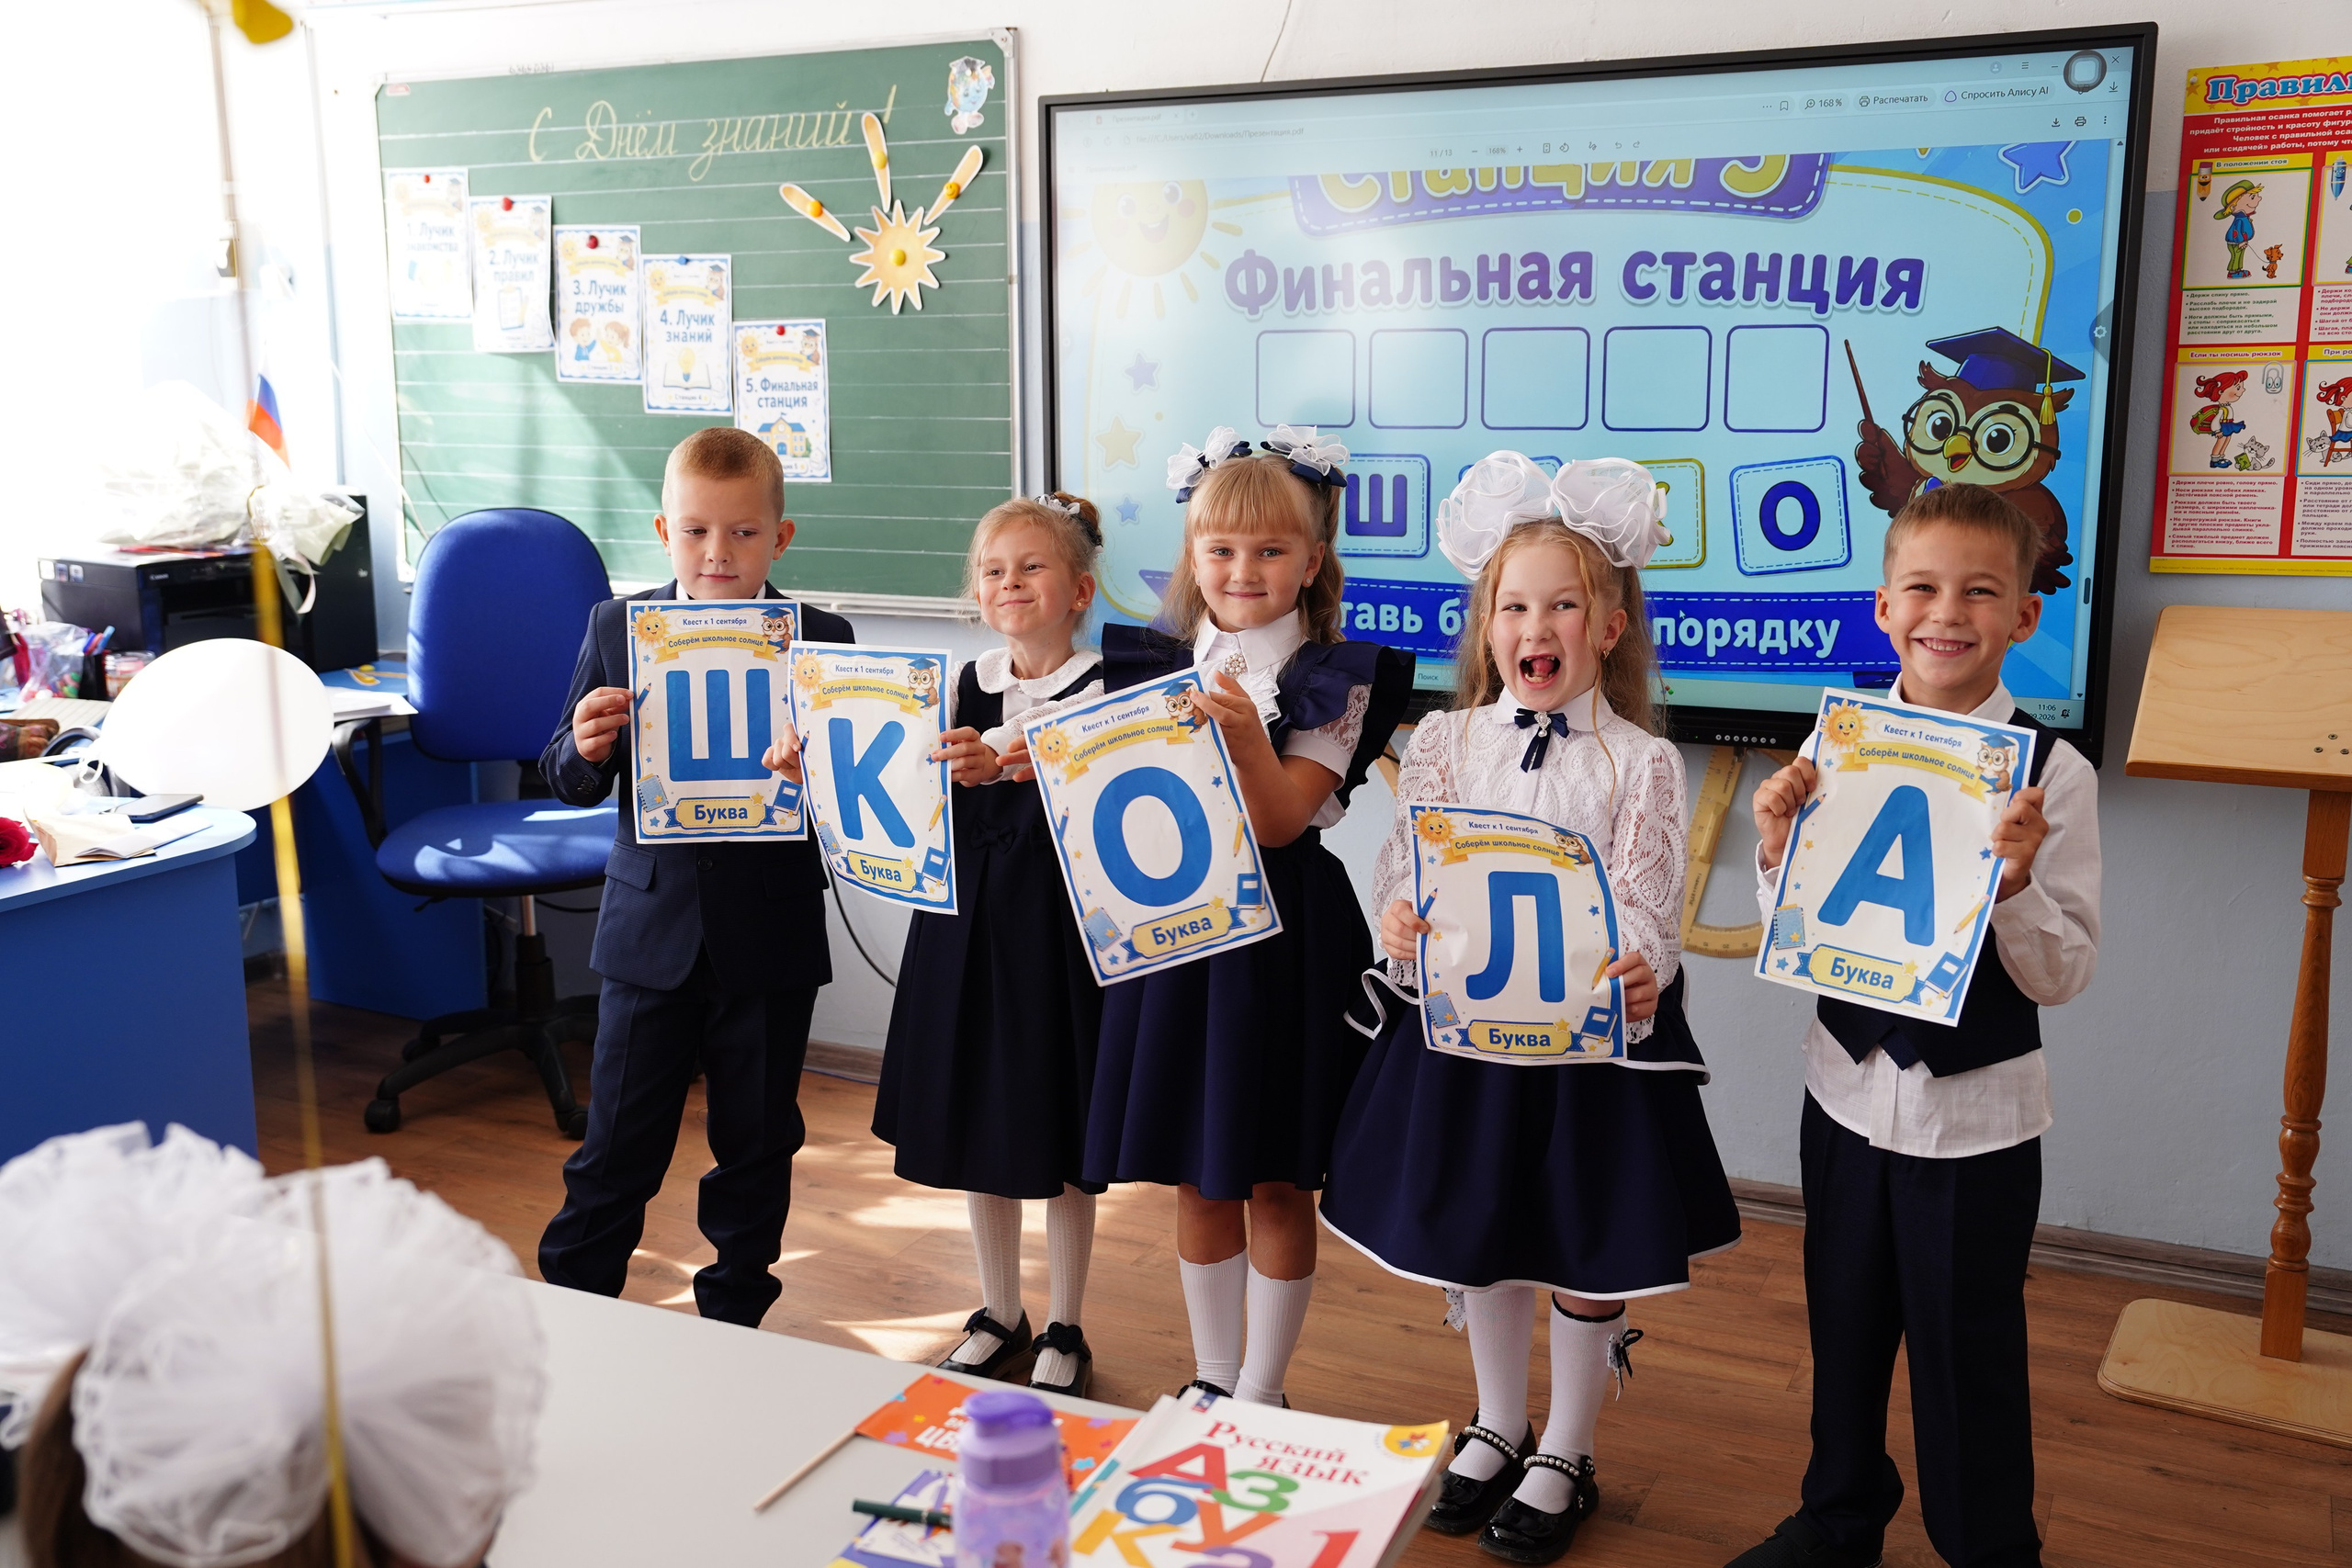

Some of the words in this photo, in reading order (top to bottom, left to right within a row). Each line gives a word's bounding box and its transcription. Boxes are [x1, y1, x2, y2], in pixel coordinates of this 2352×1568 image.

[1872, 95, 1928, 105] Распечатать
[1961, 90, 2006, 100] Спросить
[2007, 88, 2037, 97] Алису
[2214, 116, 2266, 124] Правильная
[2226, 125, 2275, 133] стройность
[2286, 121, 2321, 130] красоту
[528, 107, 552, 163] С
[574, 100, 679, 160] Днём
[2279, 130, 2333, 141] правильной
[503, 249, 539, 268] Лучик
[493, 270, 535, 285] правил
[1225, 249, 1592, 317] Финальная
[1621, 251, 1927, 316] станция
[588, 279, 627, 299] Лучик
[575, 299, 625, 316] дружбы
[676, 309, 715, 329] Лучик
[666, 328, 713, 343] знаний
[746, 378, 758, 393] 5.
[761, 377, 818, 392] Финальная
[757, 395, 808, 409] станция
[1345, 473, 1408, 537] Ш
[1758, 480, 1821, 551] О
[716, 617, 747, 626] сентября
[668, 637, 700, 648] Соберём
[739, 637, 764, 648] солнце
[1653, 617, 1840, 659] порядку
[835, 664, 853, 673] Квест
[865, 666, 894, 675] сентября
[822, 684, 851, 695] Соберём
[853, 684, 885, 694] школьное
[886, 688, 910, 700] солнце
[666, 669, 772, 782] Ш
[1081, 720, 1102, 733] Квест
[1110, 715, 1114, 723] 1
[1116, 705, 1149, 722] сентября
[1073, 740, 1105, 761] Соберём
[1107, 728, 1146, 746] школьное
[1147, 723, 1174, 735] солнце
[1884, 724, 1907, 737] Квест
[1918, 730, 1923, 739] 1
[1925, 733, 1962, 749] сентября
[1859, 747, 1899, 759] Соберём
[1901, 750, 1945, 768] школьное
[1946, 762, 1975, 780] солнце
[829, 717, 915, 848] К
[695, 805, 749, 825] Буква
[1092, 766, 1212, 907] О
[1468, 821, 1490, 830] Квест
[1505, 825, 1539, 835] сентября
[1455, 840, 1490, 850] Соберём
[1492, 840, 1531, 850] школьное
[1532, 845, 1560, 857] солнце
[859, 859, 901, 883] Буква
[1817, 785, 1935, 946] А
[1151, 916, 1213, 946] Буква
[1466, 871, 1566, 1003] Л
[1830, 957, 1894, 989] Буква
[1488, 1028, 1551, 1047] Буква
[1204, 1420, 1349, 1464] Русский
